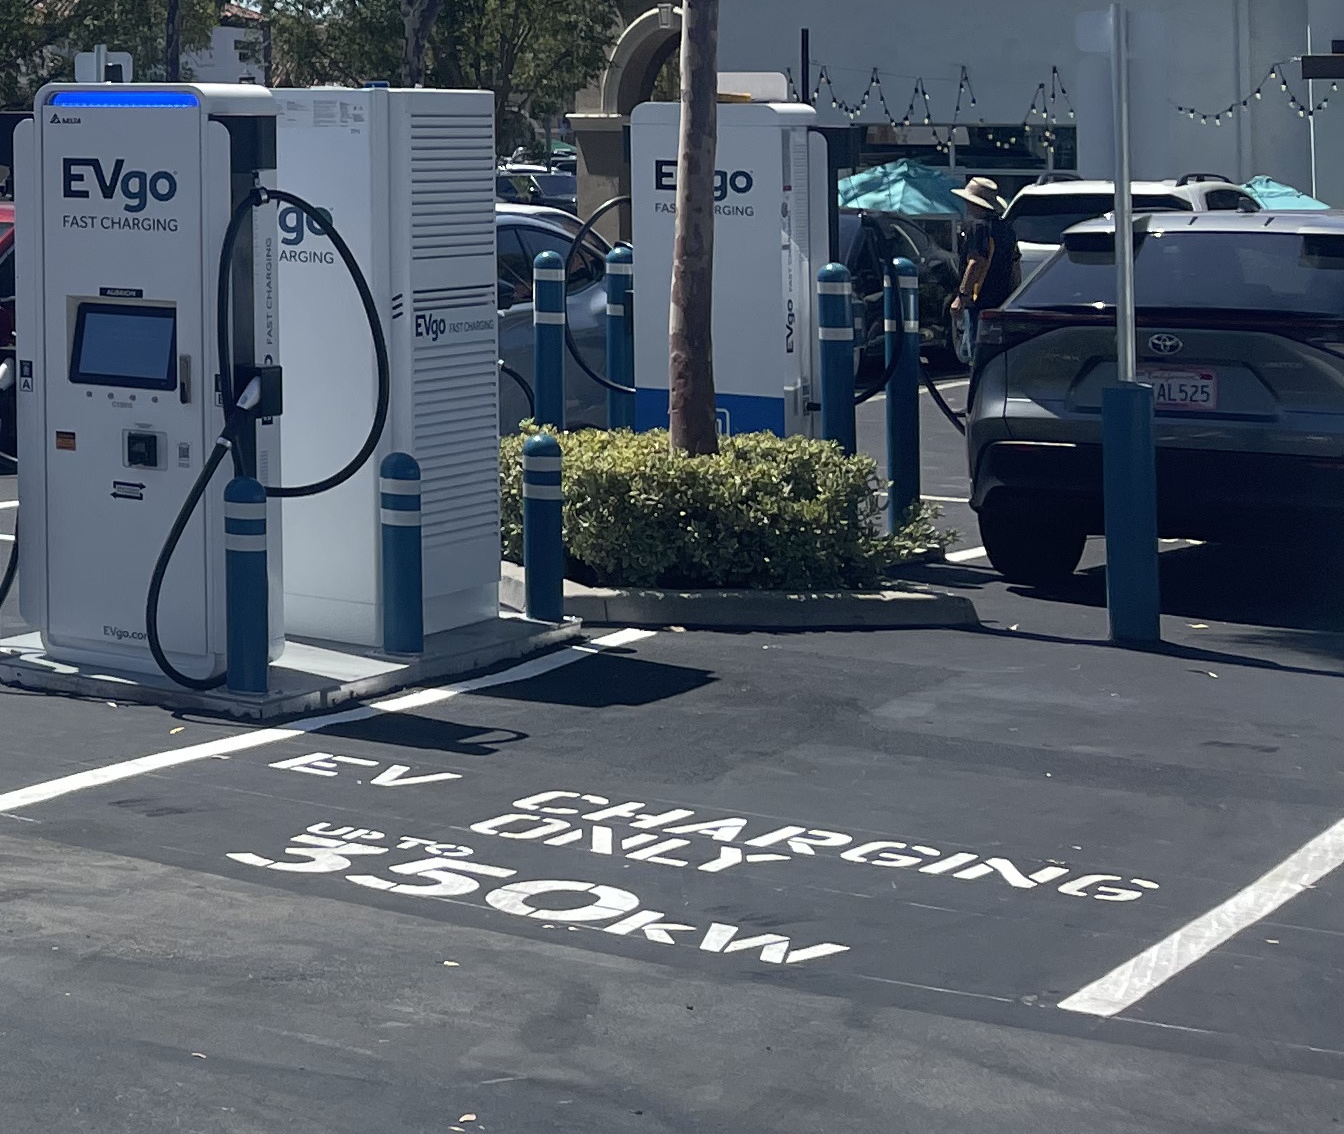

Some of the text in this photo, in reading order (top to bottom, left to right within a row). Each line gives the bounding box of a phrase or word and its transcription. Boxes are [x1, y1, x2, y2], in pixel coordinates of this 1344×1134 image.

[62, 157, 178, 213] EVgo
[655, 159, 753, 202] Ego
[63, 215, 179, 233] FAST CHARGING
[278, 205, 334, 246] go
[655, 202, 754, 217] FAS RGING
[279, 250, 335, 265] ARGING
[415, 313, 494, 342] EVgo FAST CHARGING
[785, 298, 795, 354] EVgo
[22, 379, 31, 390] A
[1153, 382, 1210, 403] AL525
[103, 625, 148, 640] EVgo.co
[267, 752, 1160, 902] EV CHARGING
[304, 822, 475, 857] UP TO
[468, 813, 793, 872] ONLY
[225, 833, 851, 964] 350kW
